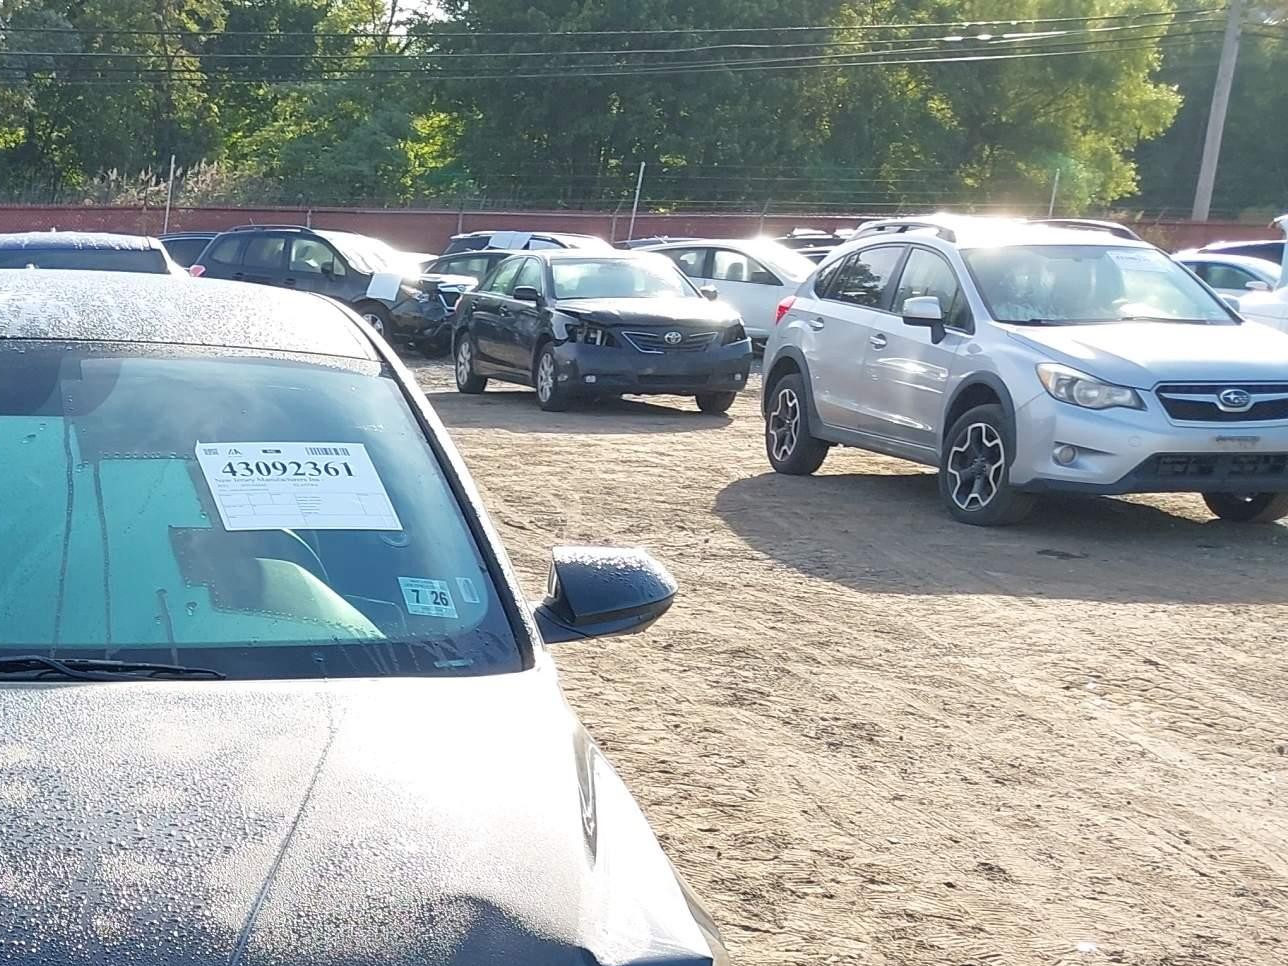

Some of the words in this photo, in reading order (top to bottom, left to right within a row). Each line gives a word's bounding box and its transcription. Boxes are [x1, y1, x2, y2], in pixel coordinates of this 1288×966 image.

[222, 461, 354, 477] 43092361
[411, 589, 420, 604] 7
[431, 590, 449, 607] 26
